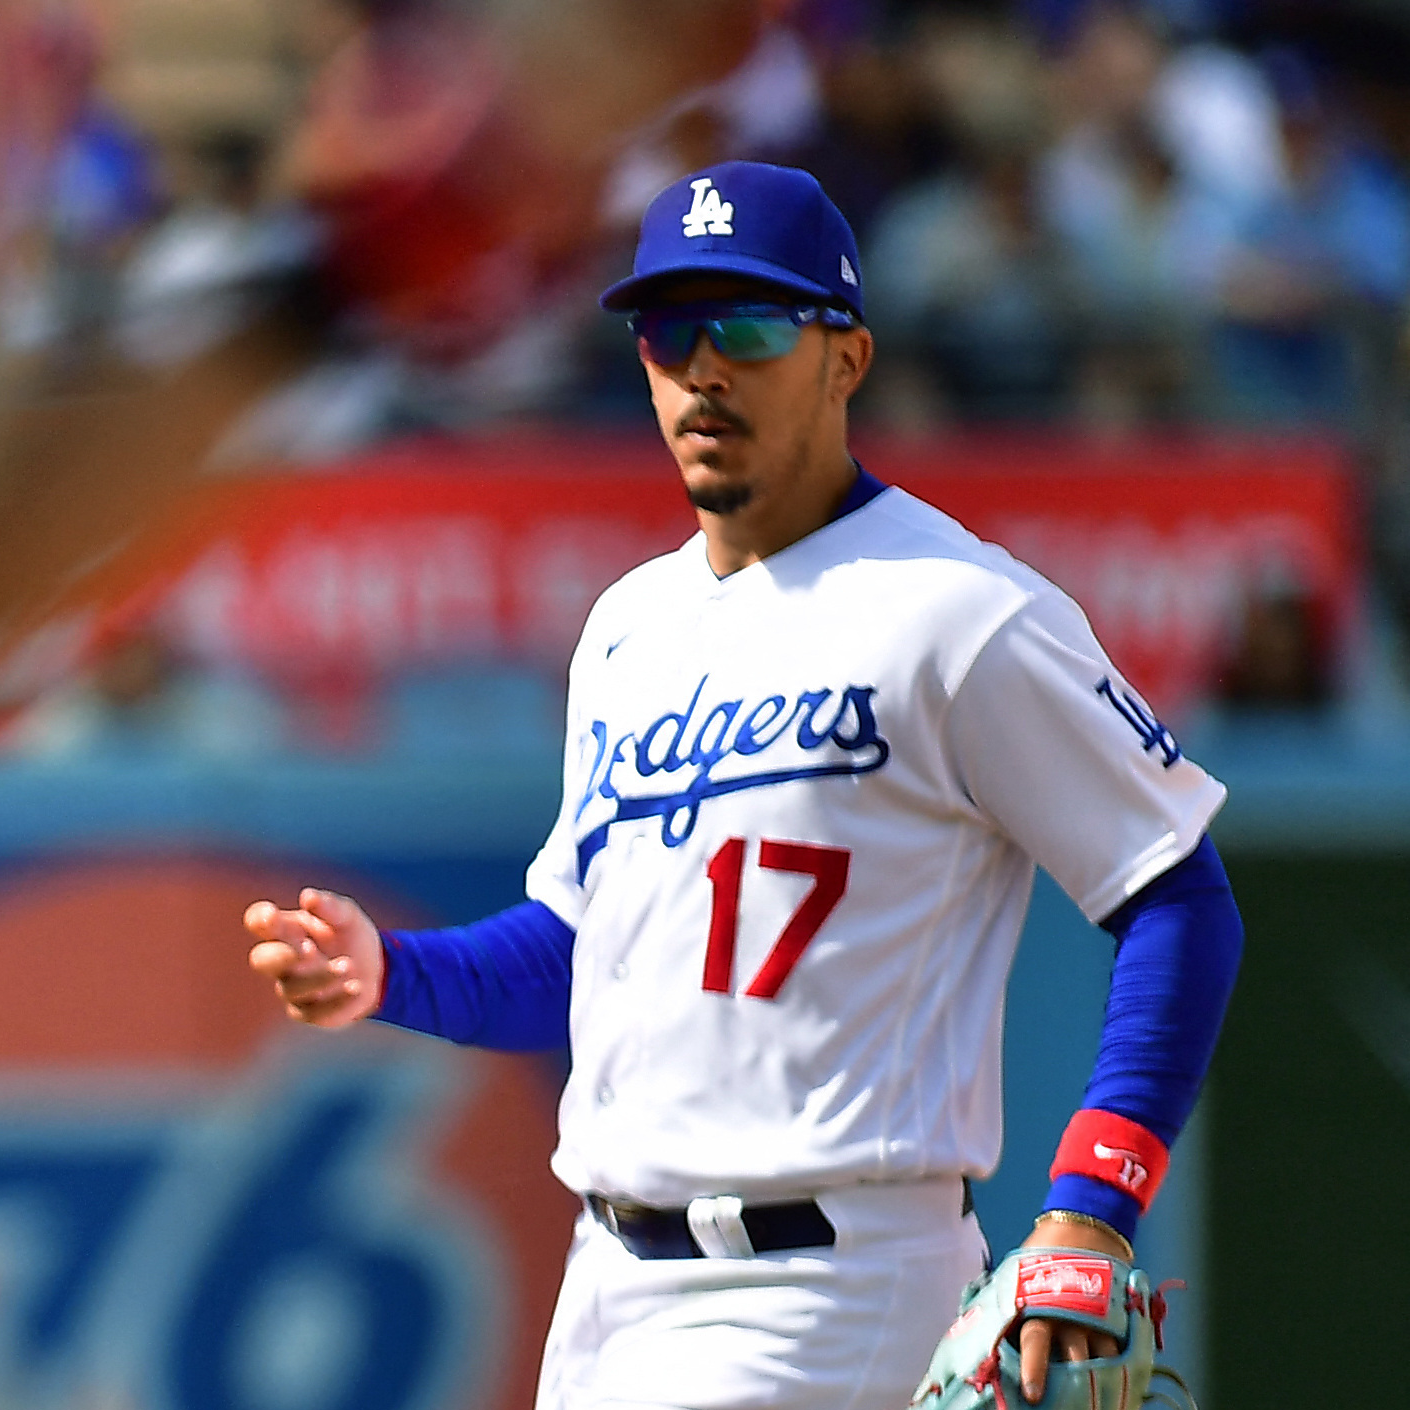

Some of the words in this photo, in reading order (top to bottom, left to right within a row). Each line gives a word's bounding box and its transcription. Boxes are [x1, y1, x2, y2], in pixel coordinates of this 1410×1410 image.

[681, 177, 734, 238] LA
[701, 837, 853, 998] 17
[1117, 1156, 1148, 1190] 17
